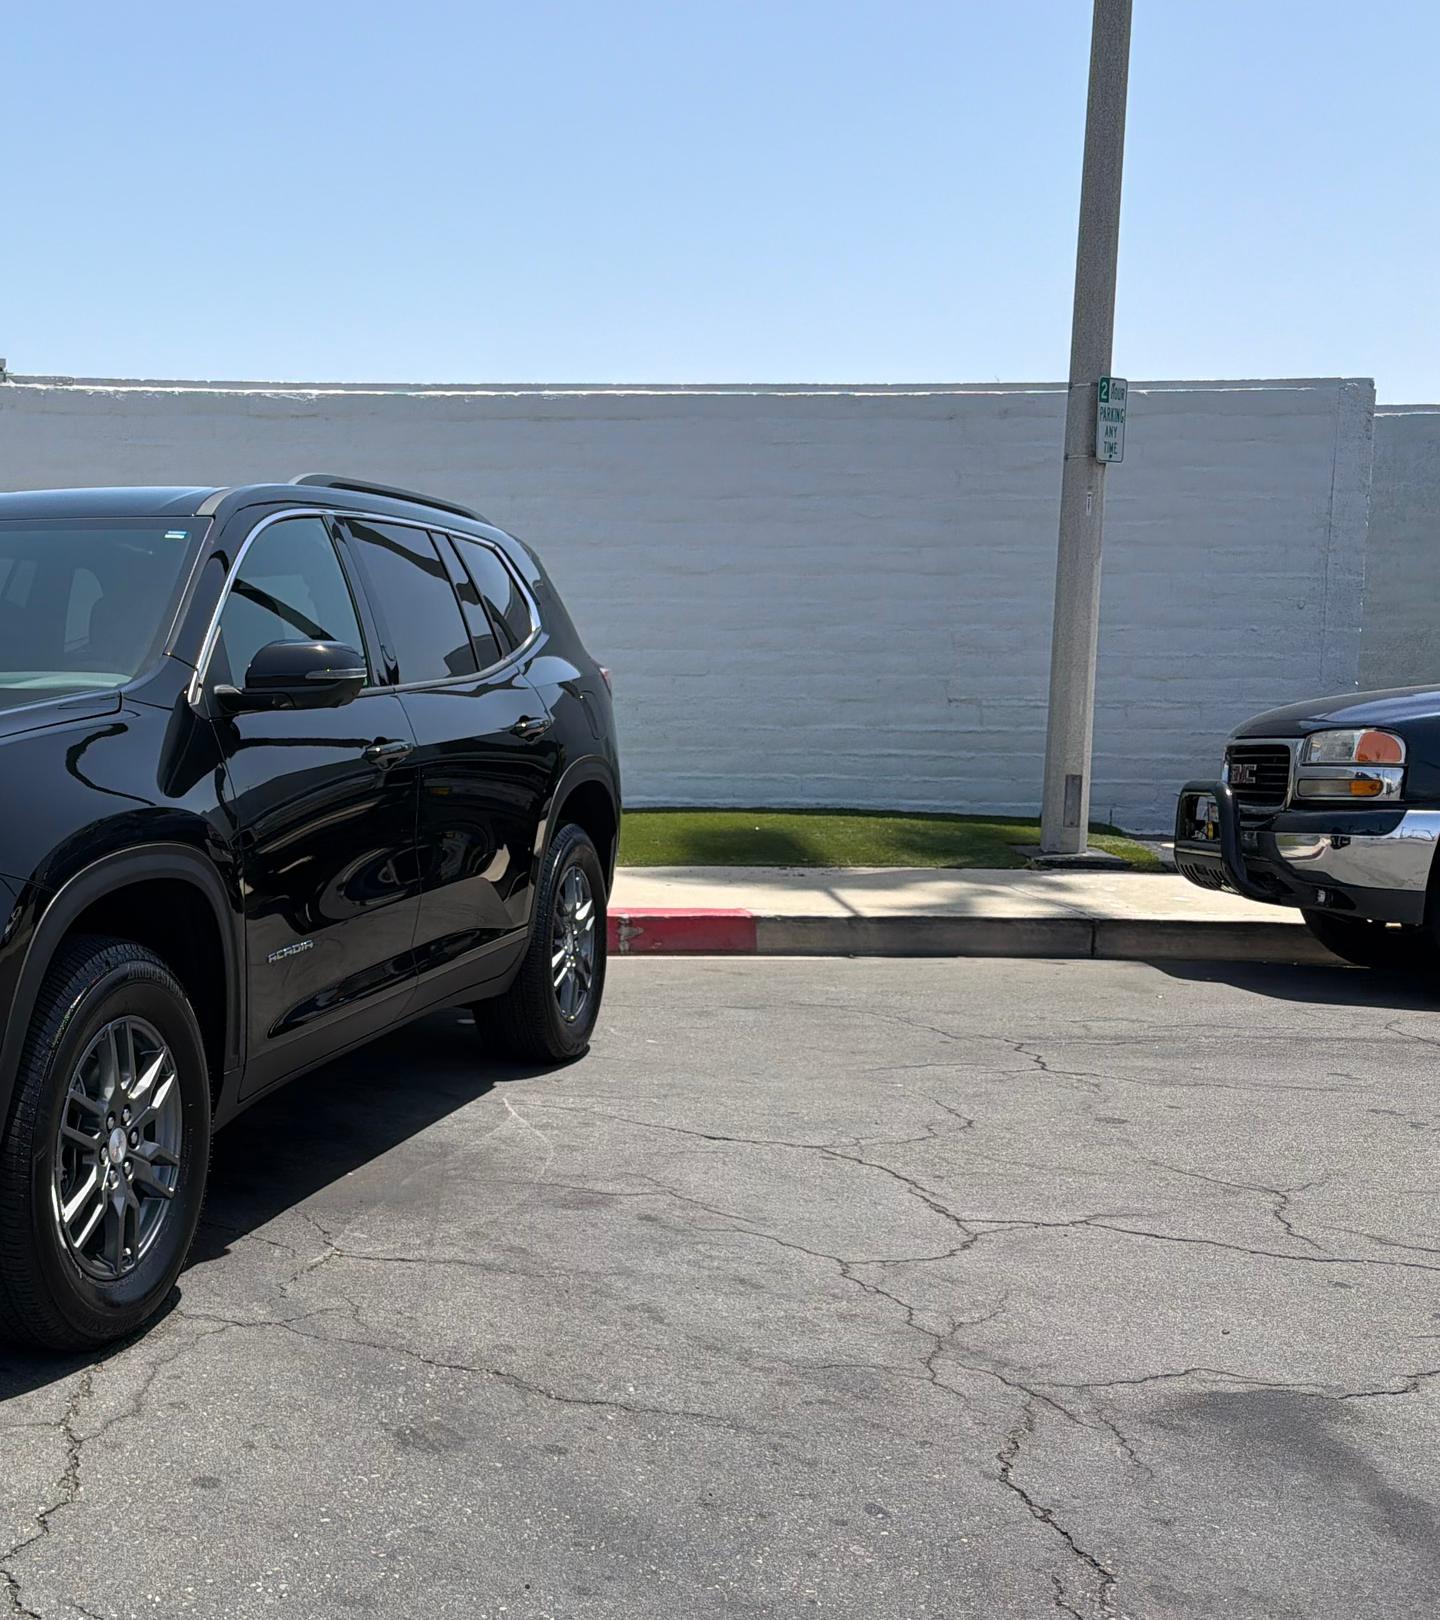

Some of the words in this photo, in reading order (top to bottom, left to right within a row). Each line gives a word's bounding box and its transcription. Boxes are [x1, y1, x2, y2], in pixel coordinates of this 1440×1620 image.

[1101, 381, 1108, 400] 2
[1100, 406, 1124, 423] PARKING
[1105, 425, 1118, 439] ANY
[1103, 441, 1118, 455] TIME
[1229, 763, 1257, 784] GMC
[268, 939, 314, 964] ACADIA
